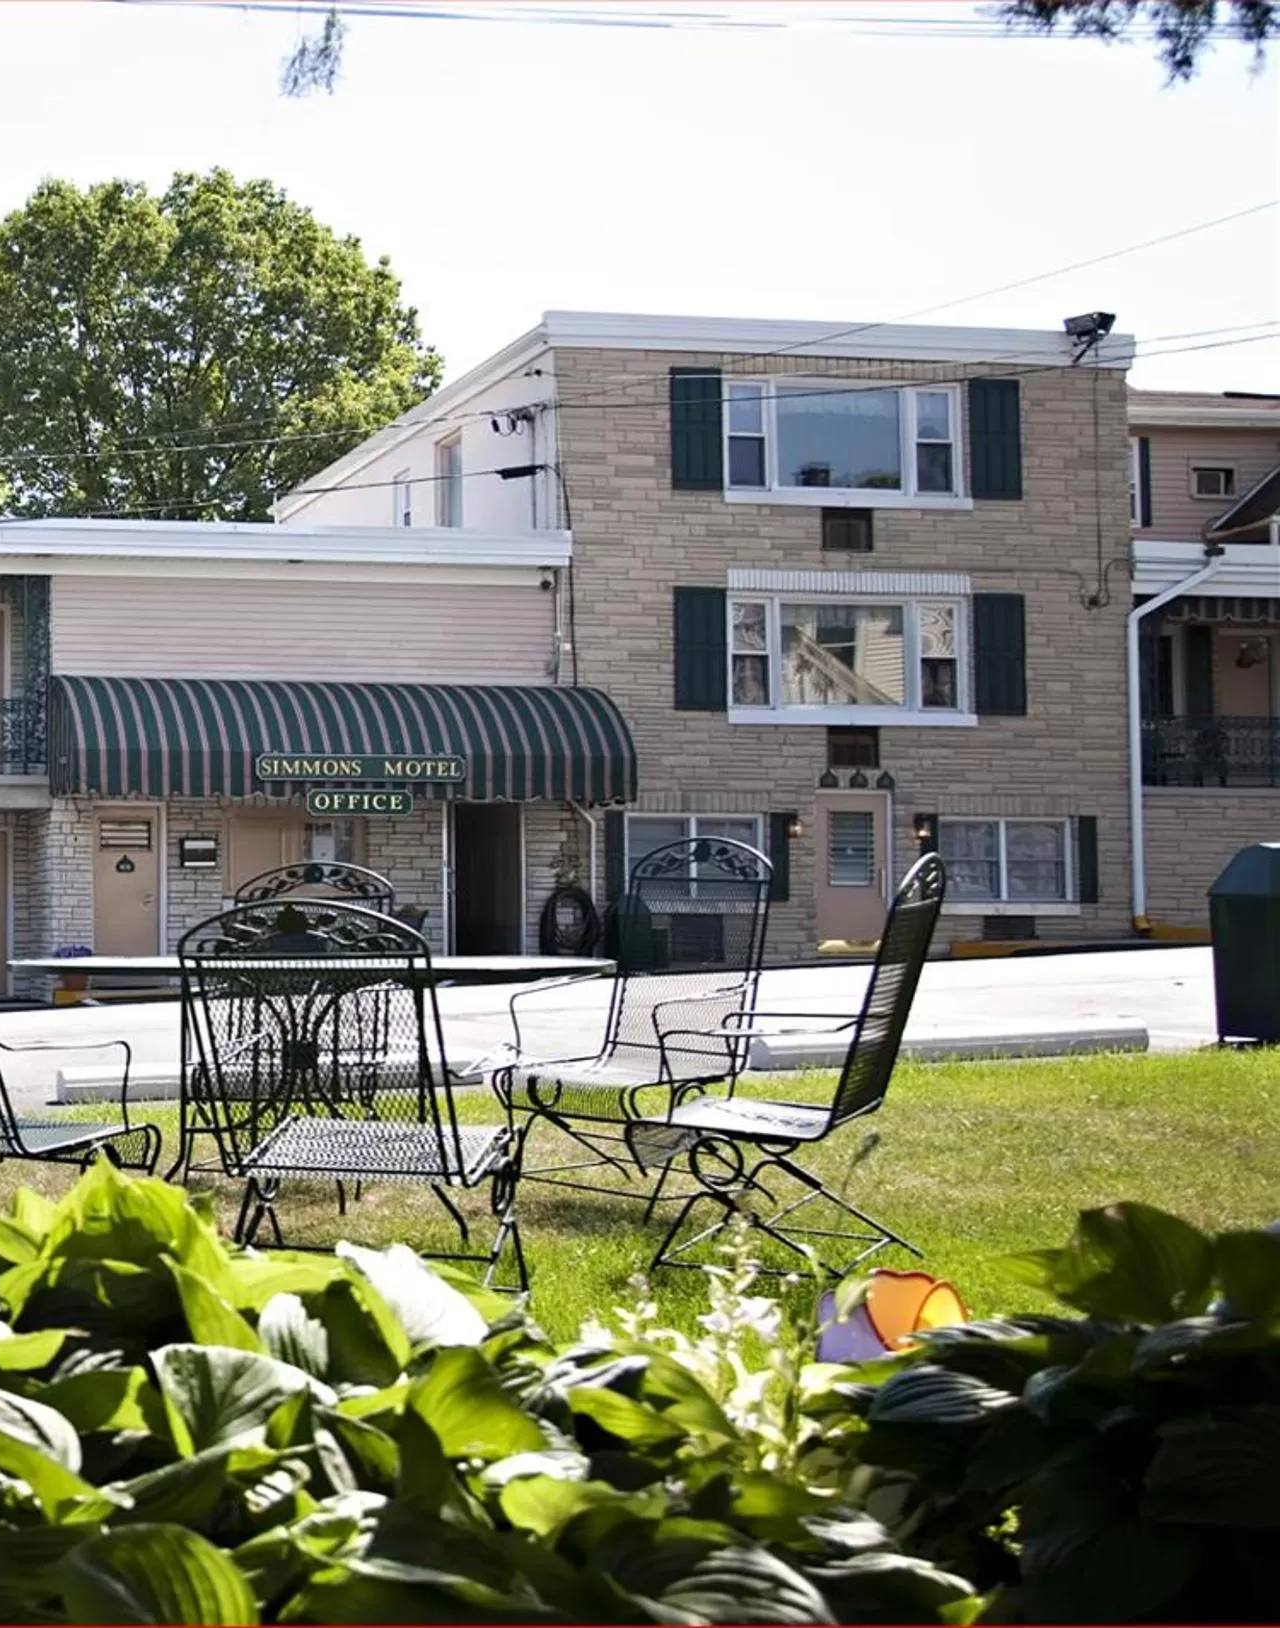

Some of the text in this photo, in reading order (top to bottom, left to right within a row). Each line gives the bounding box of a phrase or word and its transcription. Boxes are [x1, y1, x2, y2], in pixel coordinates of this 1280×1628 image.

[260, 759, 462, 777] SIMMONS MOTEL
[314, 794, 404, 811] OFFICE
